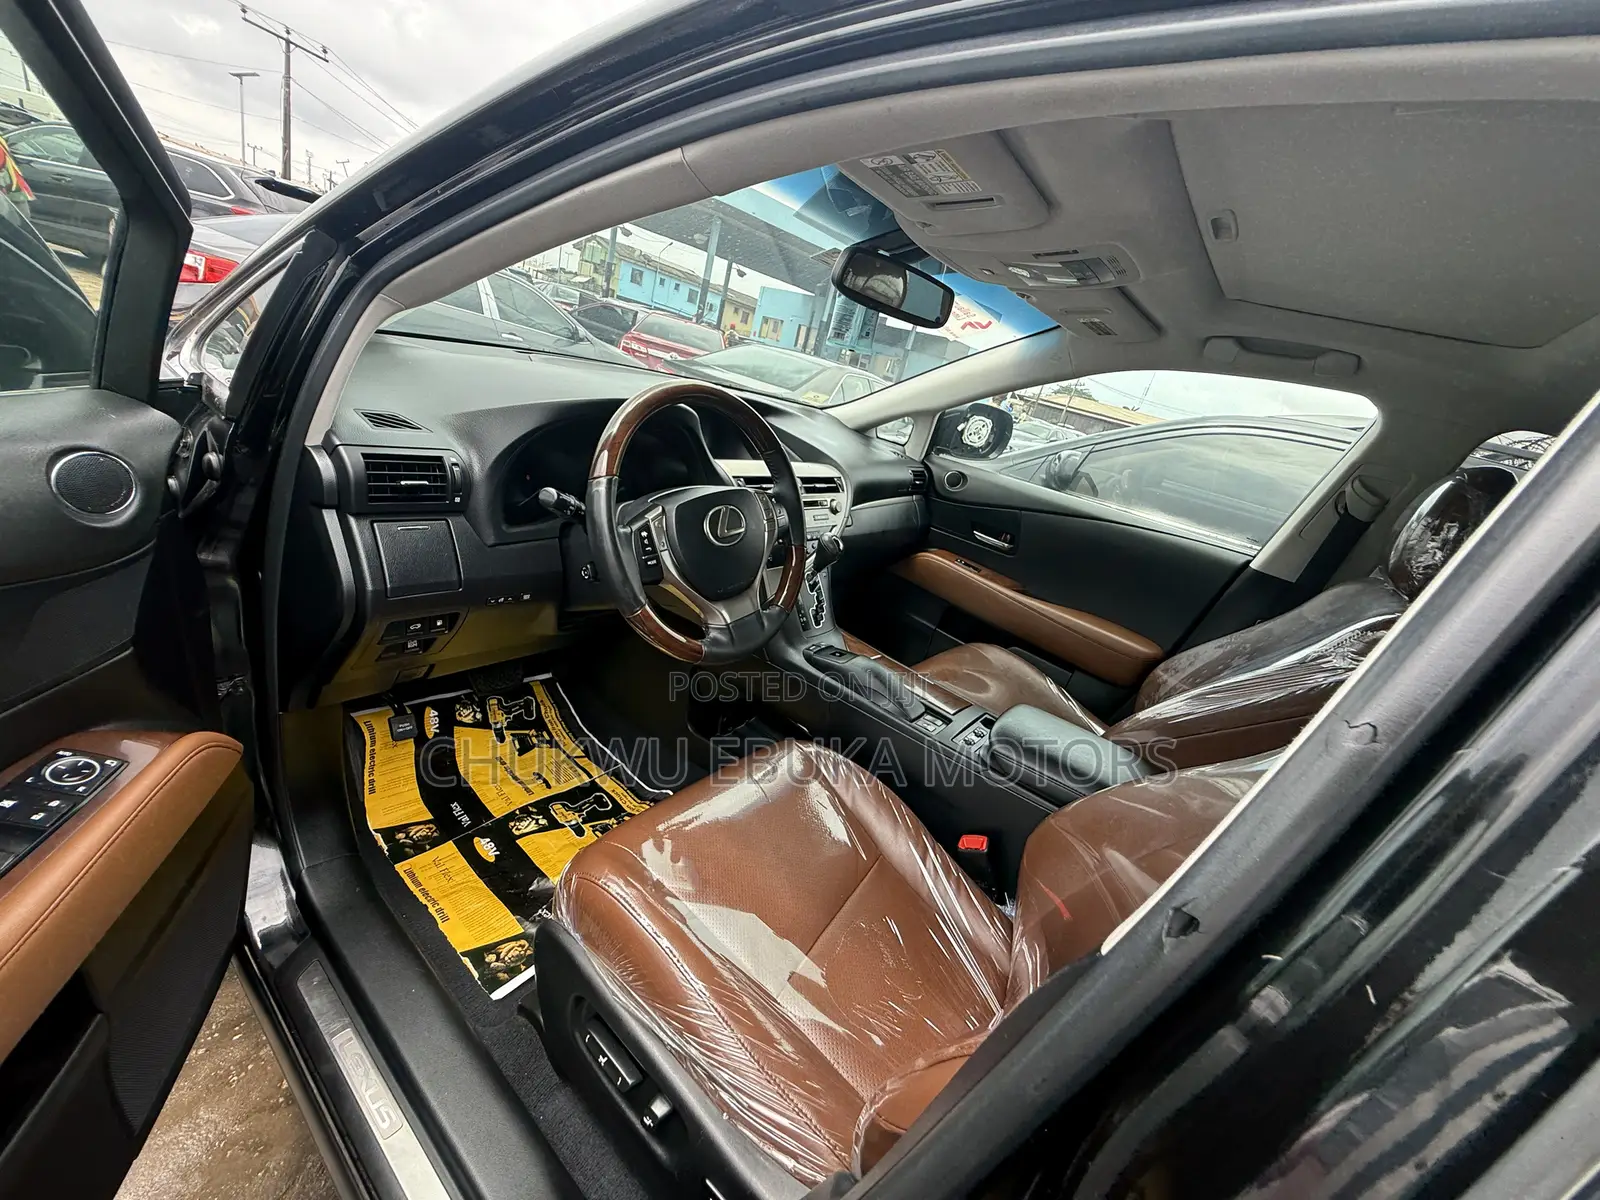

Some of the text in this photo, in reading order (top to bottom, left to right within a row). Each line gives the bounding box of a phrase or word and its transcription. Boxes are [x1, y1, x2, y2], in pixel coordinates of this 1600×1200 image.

[429, 709, 440, 733] 48V
[364, 720, 377, 795] Lithium electric drill
[450, 802, 472, 828] Val Flex
[480, 837, 500, 856] 48V
[432, 855, 454, 883] Val Flex
[403, 867, 451, 924] Lithium electric drill
[338, 1037, 397, 1129] LEXUS
